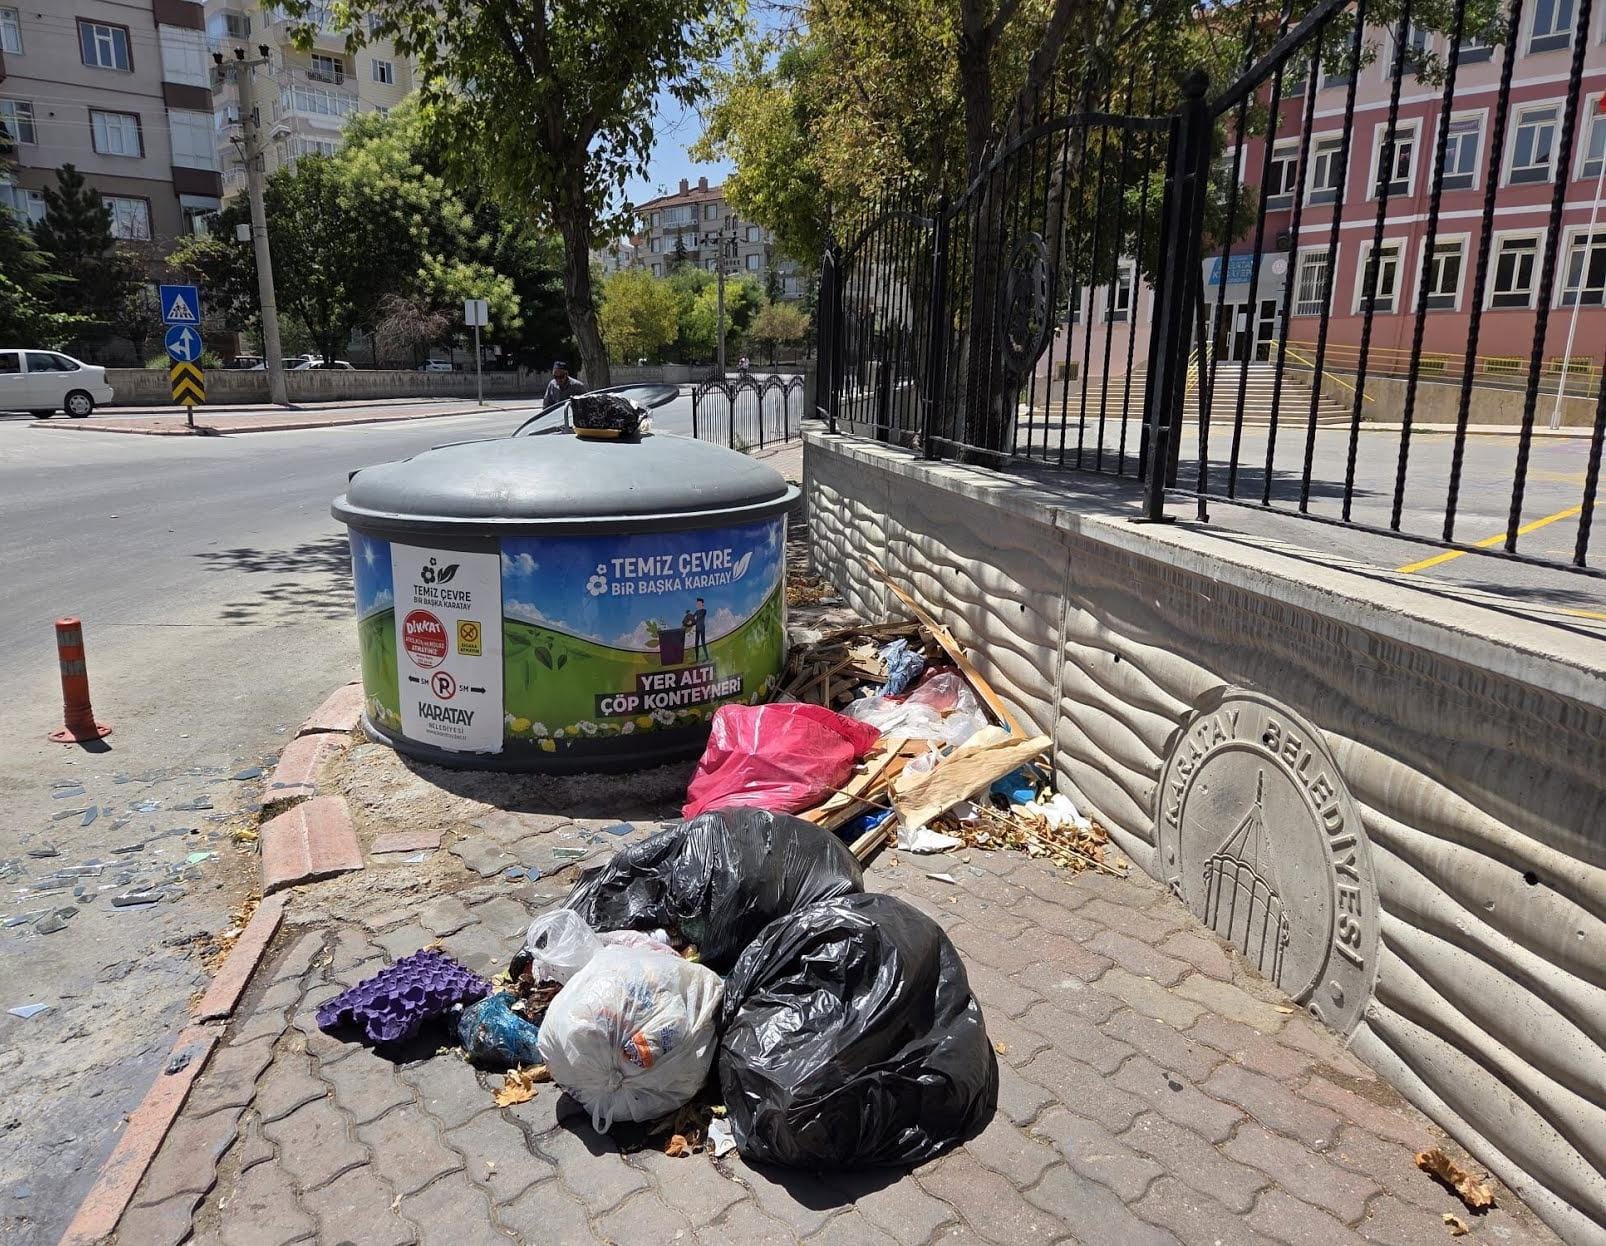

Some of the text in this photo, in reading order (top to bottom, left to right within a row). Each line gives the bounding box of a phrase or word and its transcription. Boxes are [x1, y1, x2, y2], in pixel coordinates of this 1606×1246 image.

[611, 548, 733, 579] TEMİZ ÇEVRE
[440, 588, 472, 602] ÇEVRE
[611, 571, 733, 597] BİR BAŞKA KARATAY
[443, 600, 472, 611] KARATAY
[641, 665, 715, 691] YER ALTI
[600, 676, 742, 717] ÇÖP KONTEYNERİ
[418, 701, 475, 727] KARATAY
[1164, 708, 1241, 831] KARATAY
